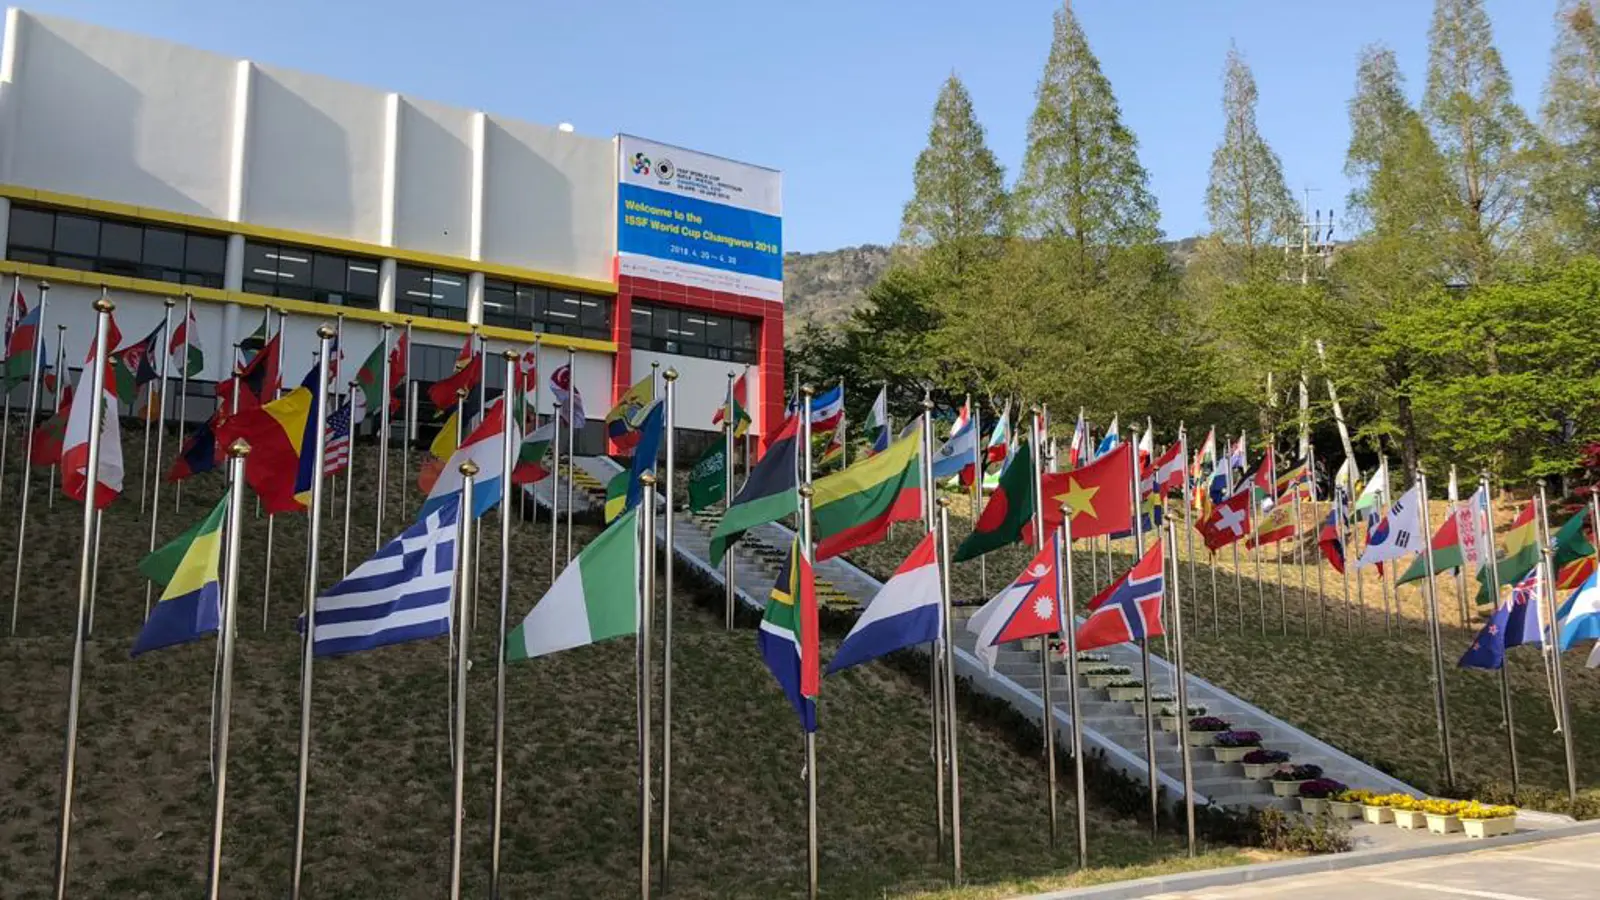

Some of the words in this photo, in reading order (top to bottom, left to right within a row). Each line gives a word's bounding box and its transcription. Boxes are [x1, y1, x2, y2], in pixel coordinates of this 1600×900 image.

[625, 200, 672, 218] Welcome
[674, 209, 685, 220] to
[686, 211, 703, 225] the
[625, 214, 648, 228] ISSF
[649, 219, 680, 235] World
[681, 225, 702, 241] Cup
[703, 229, 754, 248] Changwon
[754, 240, 778, 255] 2018
